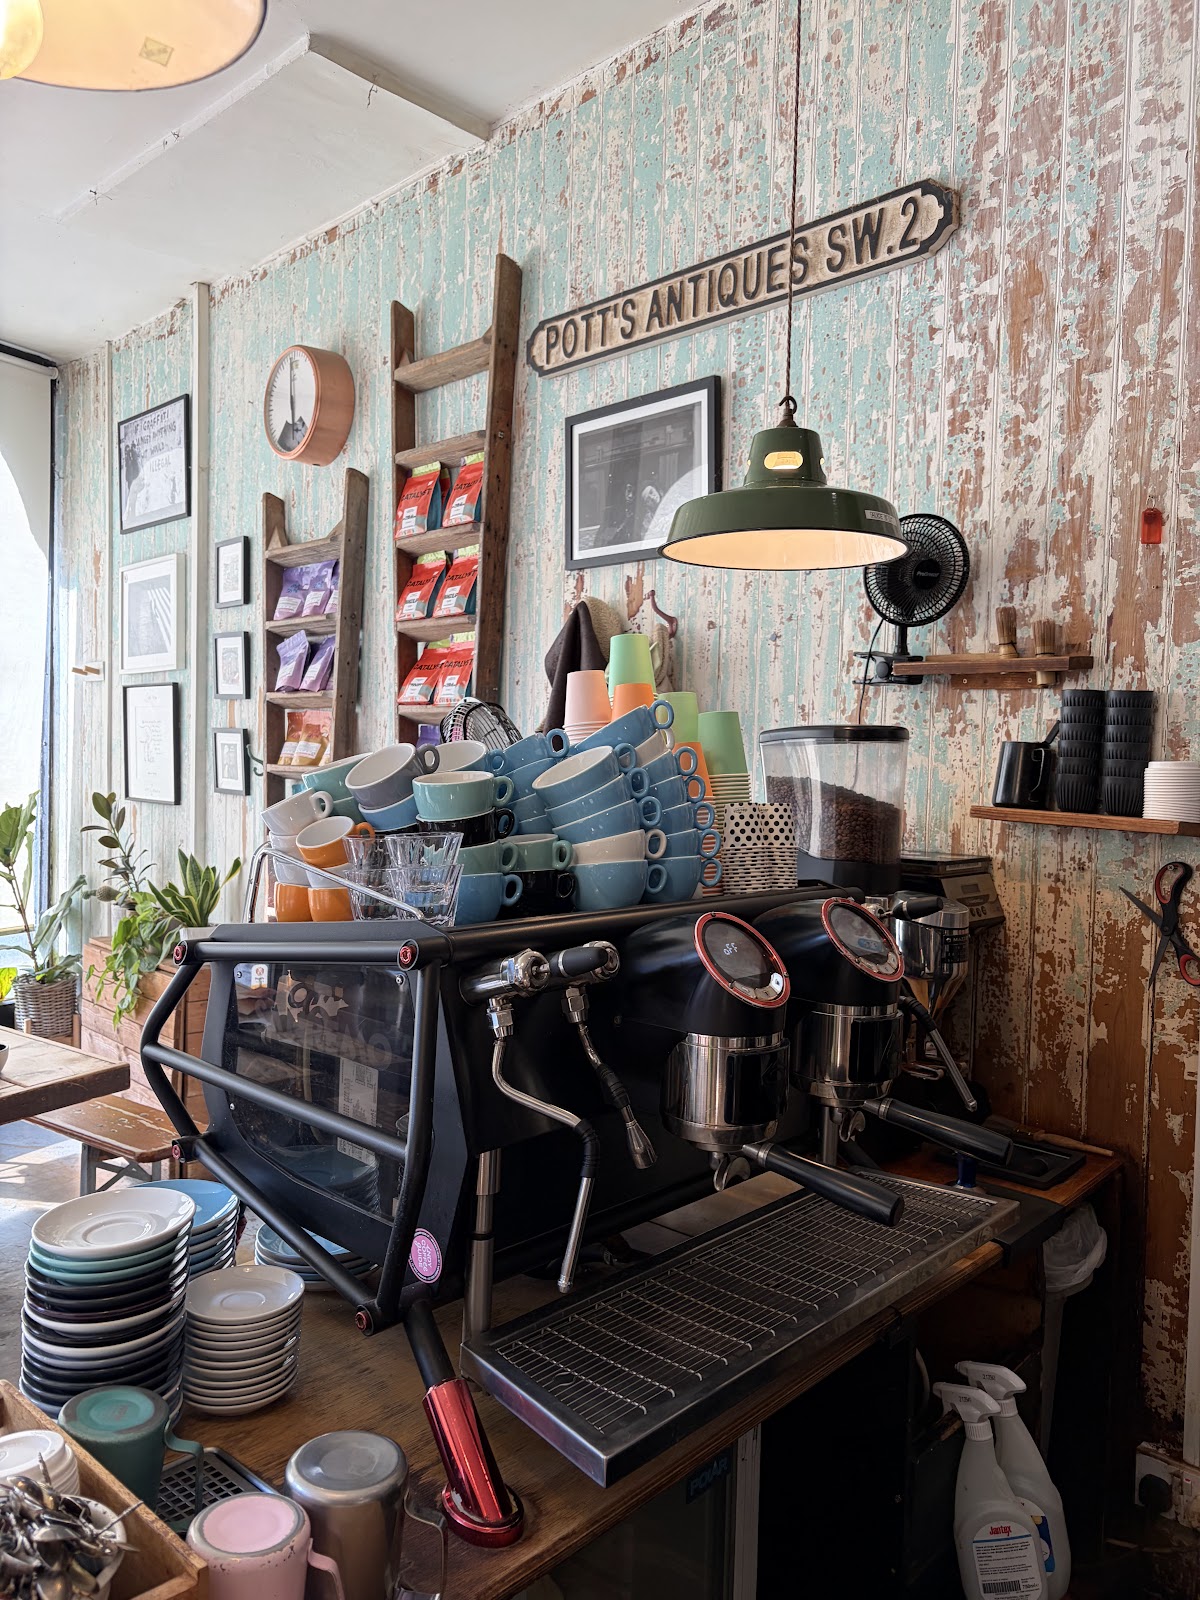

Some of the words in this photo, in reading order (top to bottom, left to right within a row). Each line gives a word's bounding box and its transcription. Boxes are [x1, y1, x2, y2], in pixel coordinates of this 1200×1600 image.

[545, 297, 637, 366] POTT'S
[645, 236, 810, 333] ANTIQUES
[826, 196, 920, 274] SW.2
[989, 1525, 1012, 1537] Jantex
